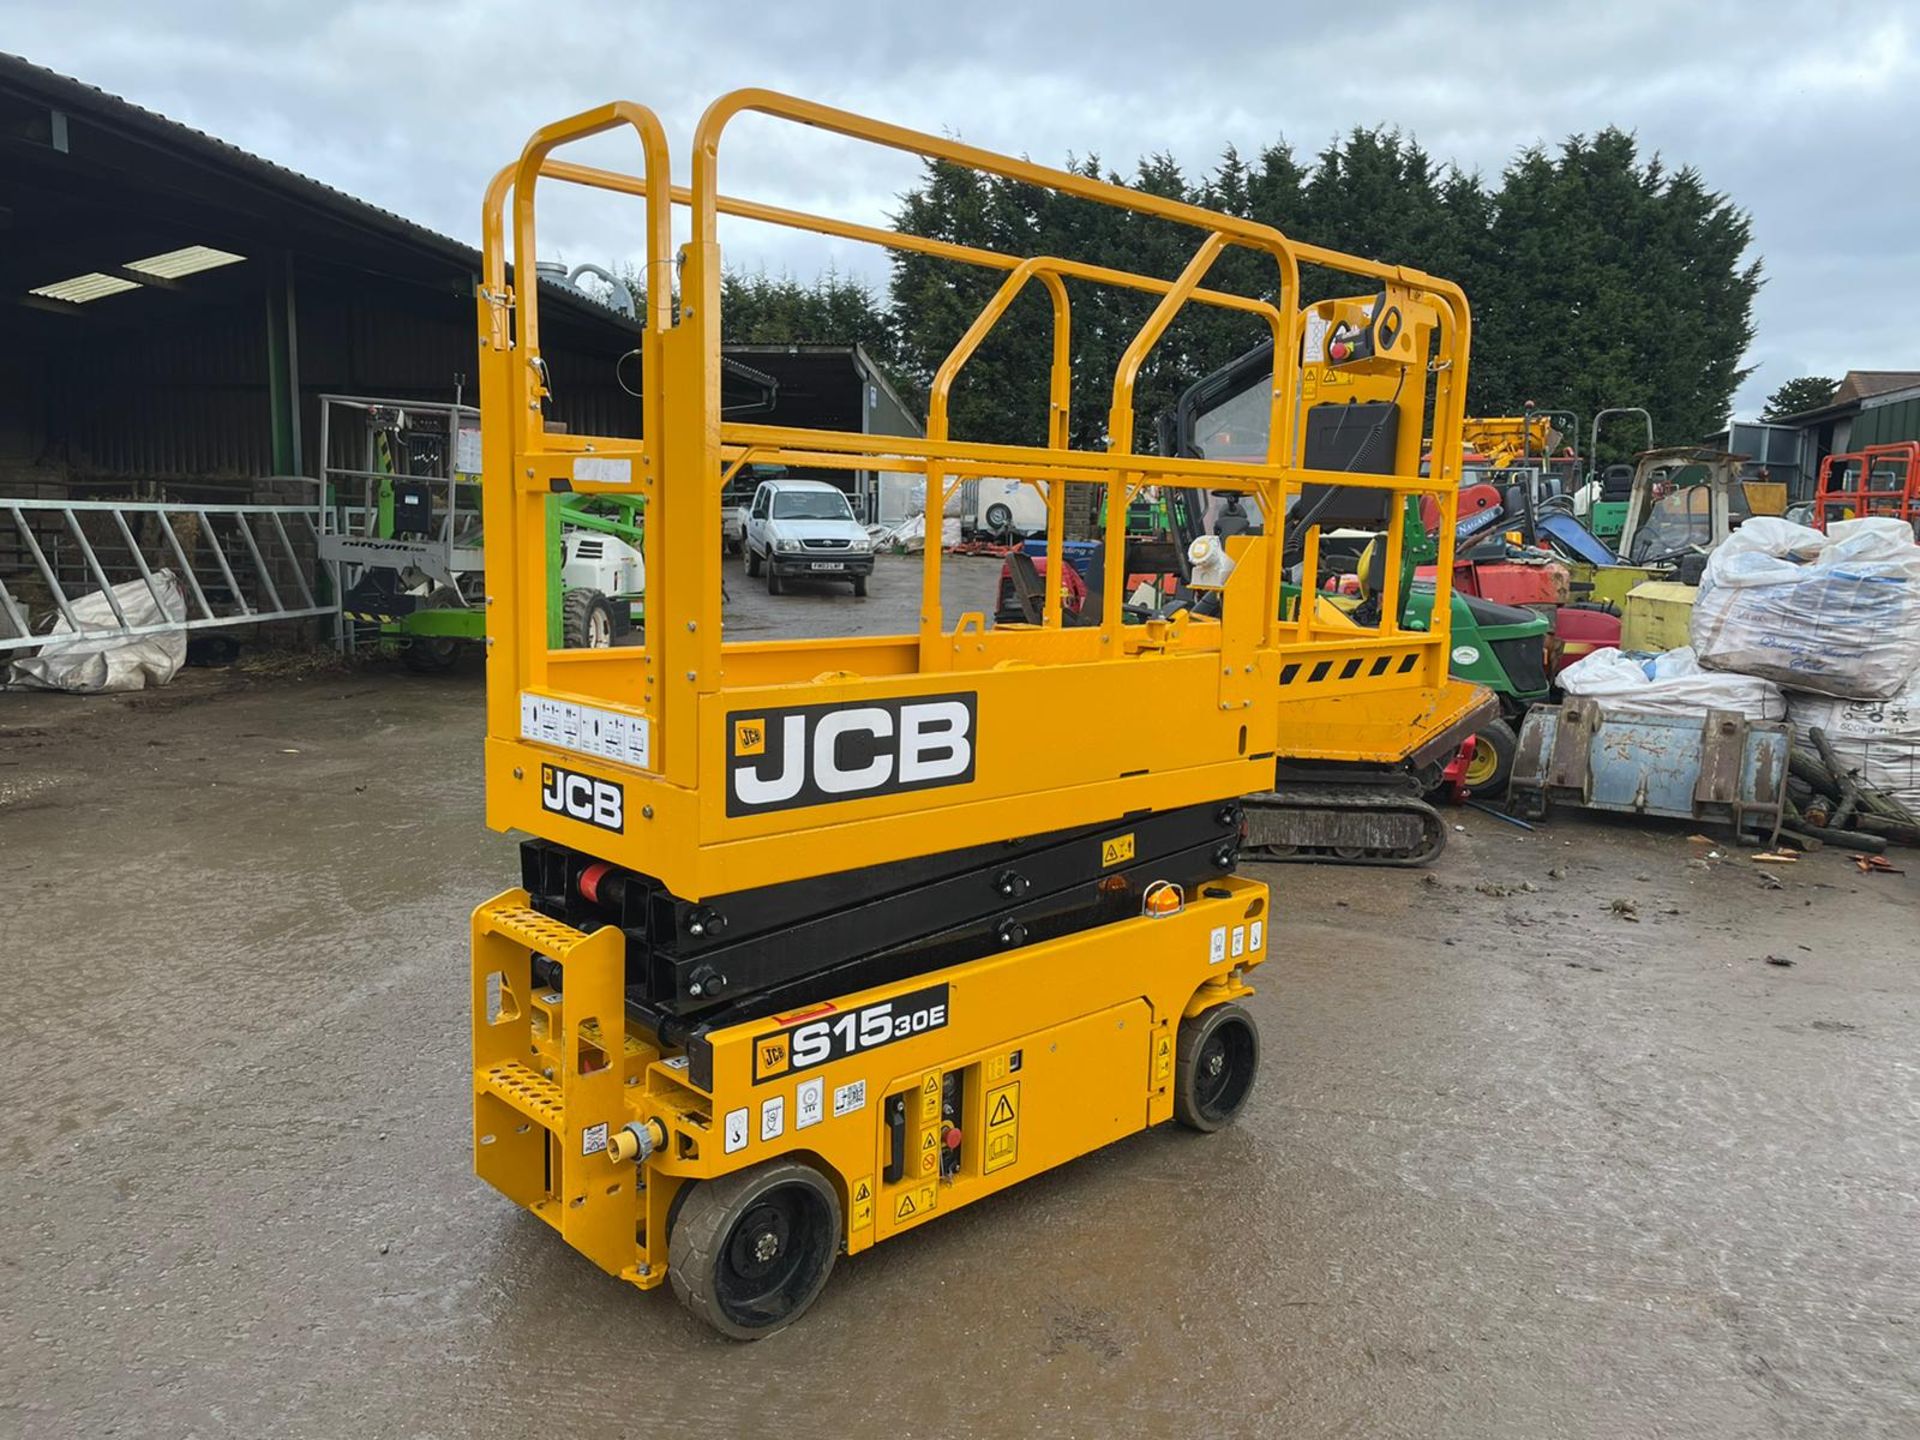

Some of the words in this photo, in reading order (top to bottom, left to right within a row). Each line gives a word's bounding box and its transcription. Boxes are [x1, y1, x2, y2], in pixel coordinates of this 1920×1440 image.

[735, 701, 971, 804] JCB
[742, 728, 760, 747] JCB
[543, 771, 622, 829] JCB
[766, 1046, 784, 1067] JCB
